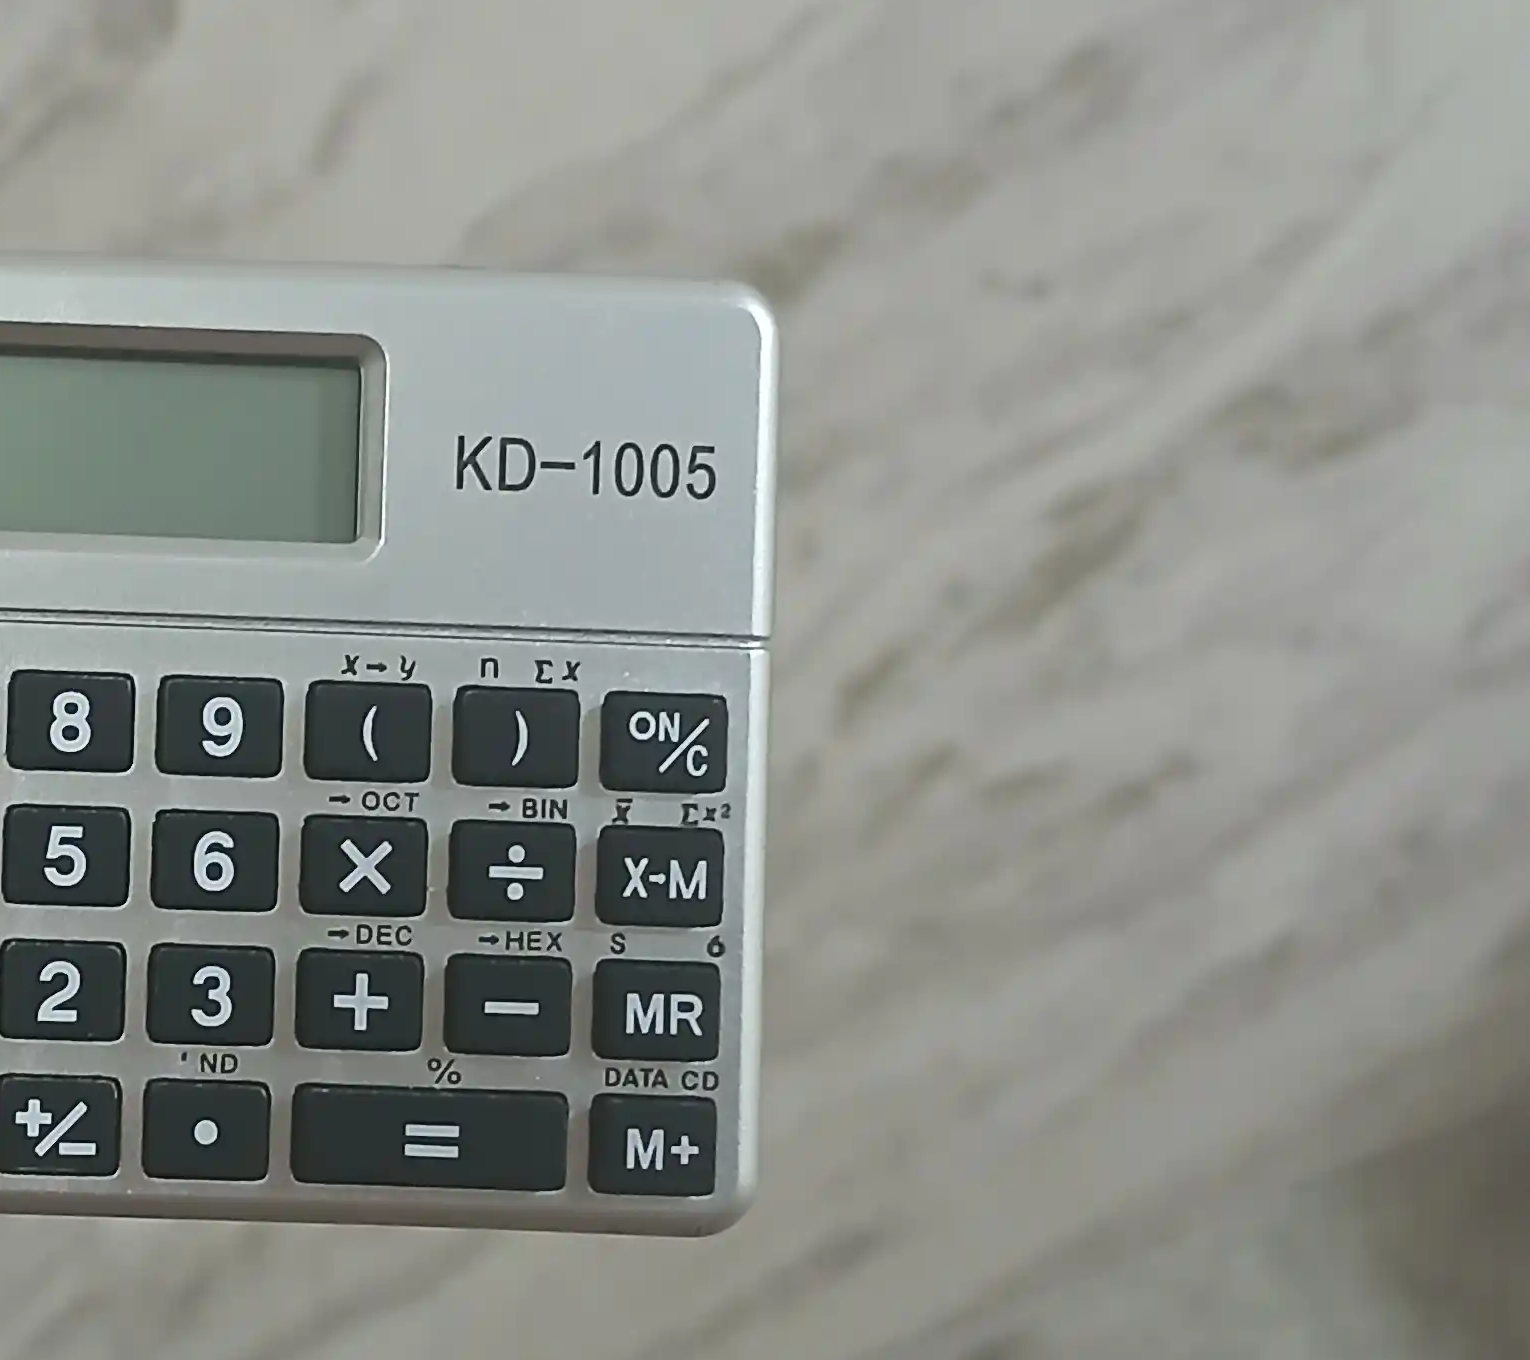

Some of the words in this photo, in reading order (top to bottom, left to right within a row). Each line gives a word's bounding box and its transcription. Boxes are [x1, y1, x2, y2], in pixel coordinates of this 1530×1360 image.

[456, 435, 716, 500] KD-1005
[49, 691, 91, 753] 8
[201, 696, 243, 757] 9
[362, 792, 419, 813] OCT
[522, 799, 568, 821] BIN
[43, 825, 87, 887] 5
[193, 830, 235, 892] 6
[356, 925, 413, 945] DEC
[506, 932, 562, 952] HEX
[37, 961, 81, 1023] 2
[190, 965, 233, 1027] 3
[625, 993, 704, 1036] MR
[428, 1058, 461, 1084] %
[604, 1067, 668, 1088] DATA
[681, 1071, 719, 1091] CD
[625, 1128, 699, 1171] M+
